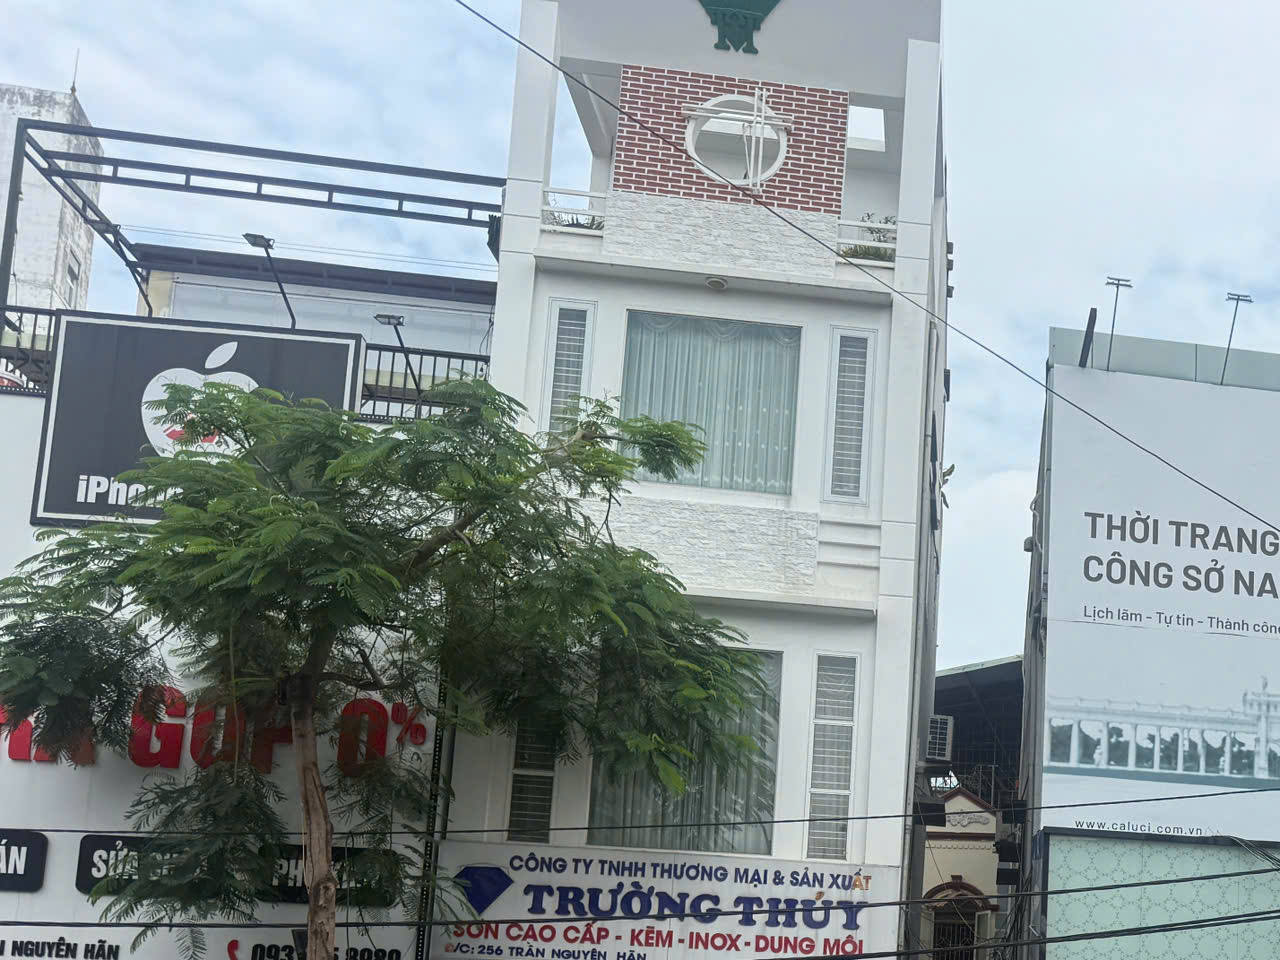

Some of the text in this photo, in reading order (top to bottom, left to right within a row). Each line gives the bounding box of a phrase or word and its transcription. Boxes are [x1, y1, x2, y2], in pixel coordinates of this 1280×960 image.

[1084, 510, 1280, 557] THỜI TRANG
[1083, 551, 1173, 588] CÔNG
[1182, 560, 1225, 594] SỞ
[1083, 605, 1116, 623] Lịch
[1118, 606, 1143, 623] lãm
[1155, 610, 1173, 628] Tự
[1175, 612, 1194, 627] tin
[1207, 613, 1249, 632] Thành
[1074, 818, 1203, 837] www.caluci.com.vn
[509, 852, 872, 891] CÔNG TY TNHH THƯƠNG MẠI & SẢN XUẤT
[523, 881, 722, 924] TRƯỜNG
[11, 937, 78, 960] NGUYÊN
[83, 939, 120, 960] HÃN
[478, 945, 503, 956] 256
[508, 942, 545, 958] TRẦN
[551, 948, 607, 960] NGUYÊN
[506, 923, 556, 943] CAO
[563, 920, 610, 945] CẤP
[688, 931, 742, 952] INOX
[755, 935, 816, 954] DUNG
[823, 935, 864, 956] MÔI
